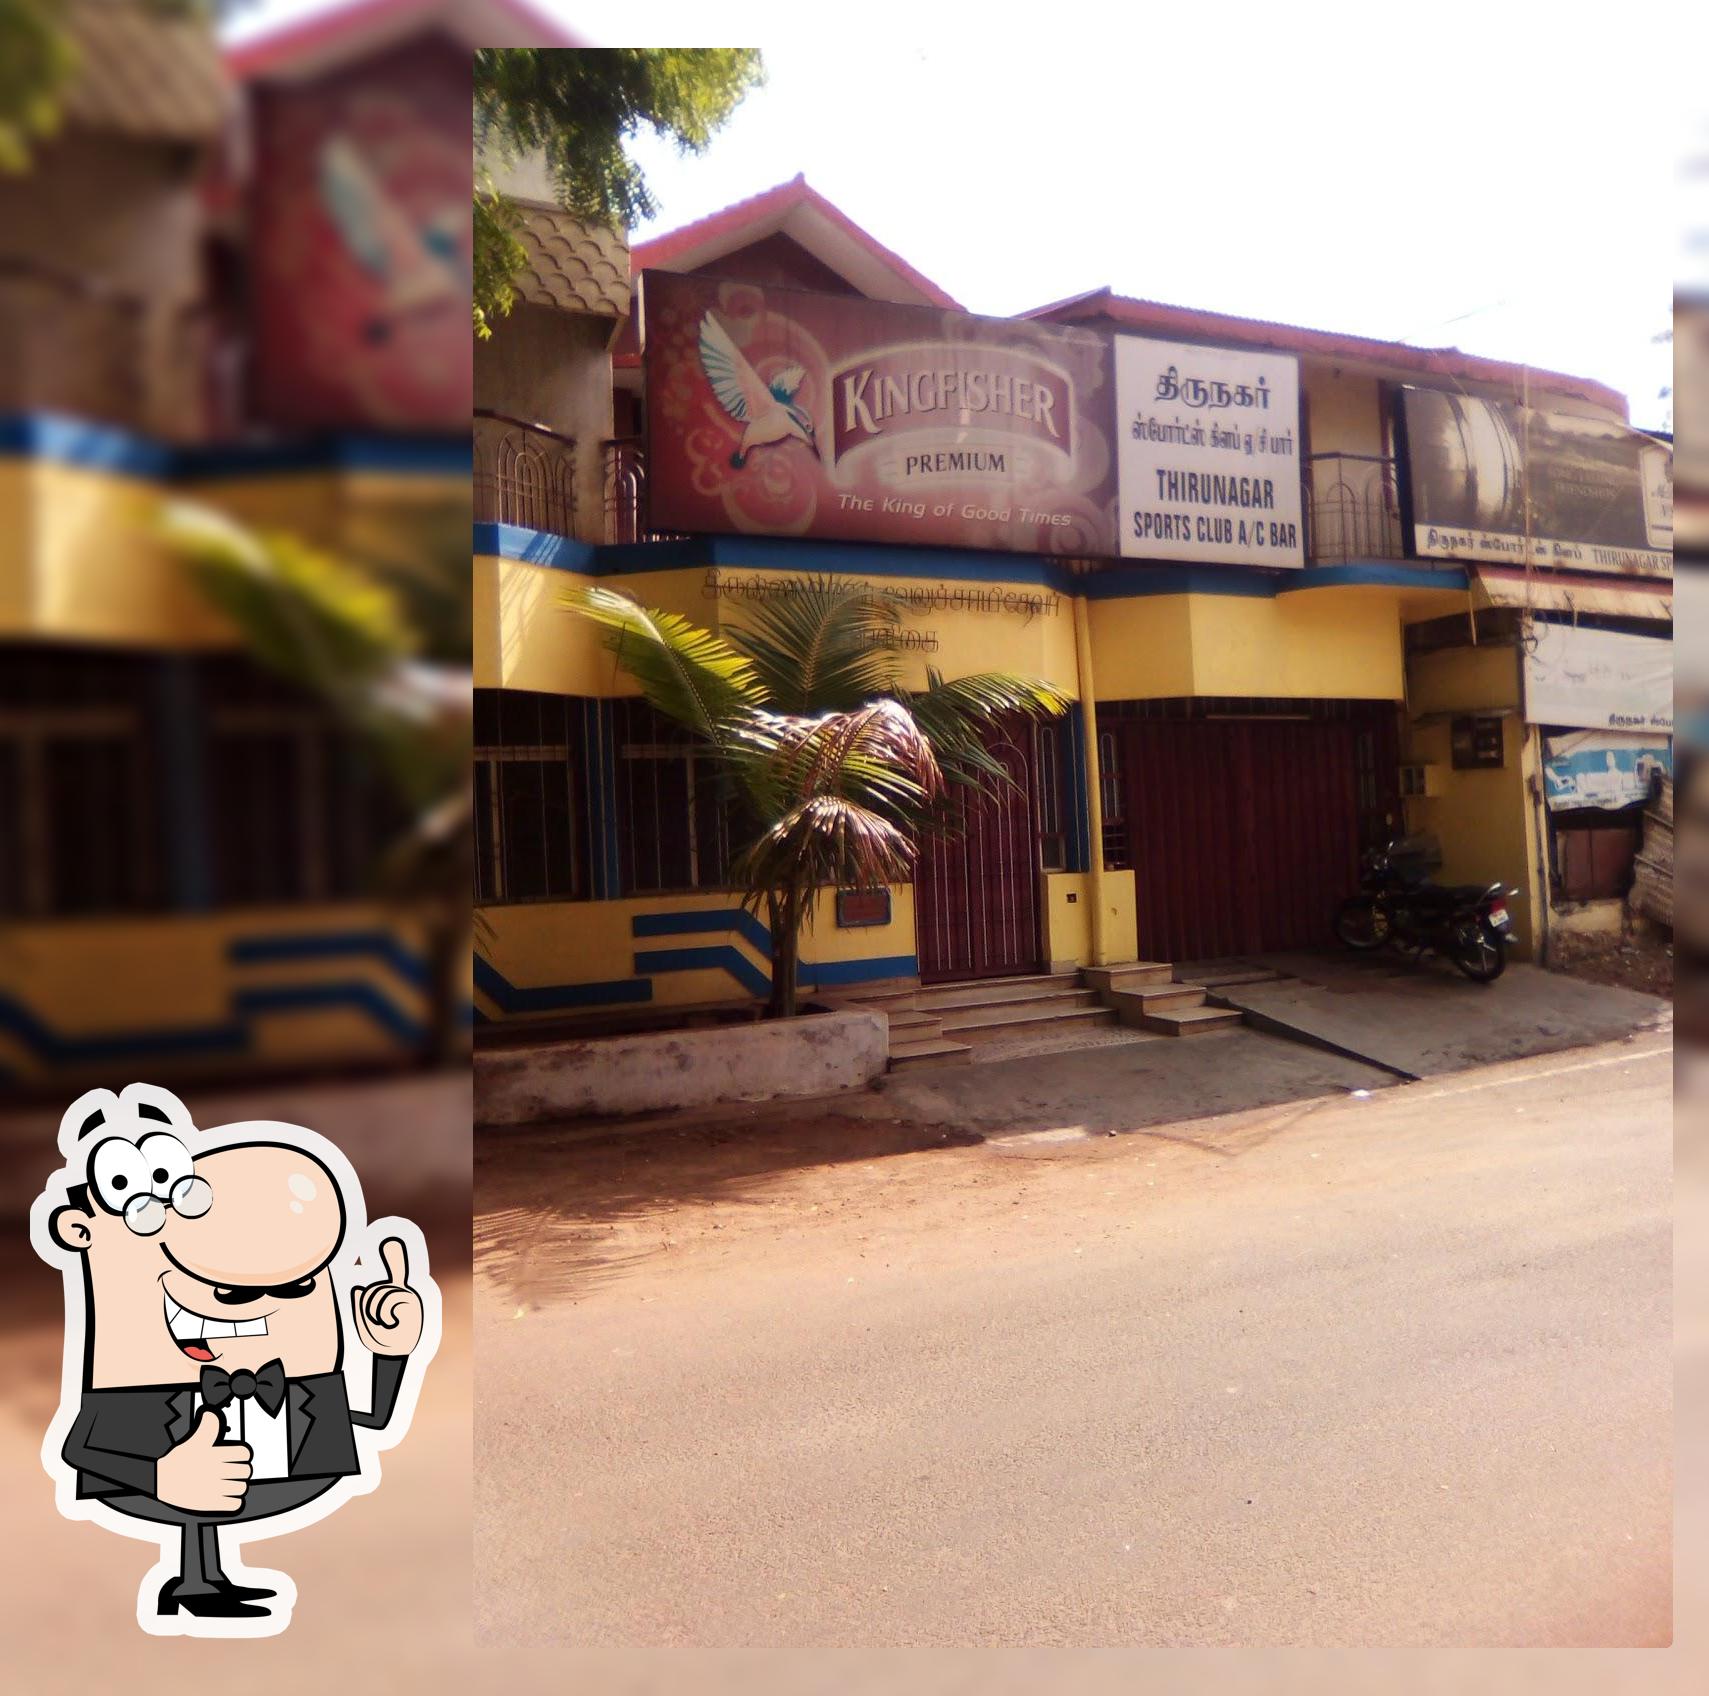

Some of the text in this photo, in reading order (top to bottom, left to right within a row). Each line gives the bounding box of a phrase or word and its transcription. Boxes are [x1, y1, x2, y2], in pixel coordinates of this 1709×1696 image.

[842, 368, 1061, 438] KINGFISHER
[1155, 366, 1271, 410] திருநகர்
[1270, 429, 1293, 456] பார்
[905, 451, 1006, 476] PREMIUM
[1156, 469, 1275, 510] THIRUNAGAR
[837, 494, 1072, 527] The King of Good Times
[1133, 511, 1297, 549] SPORTS CLUB A/C BAR
